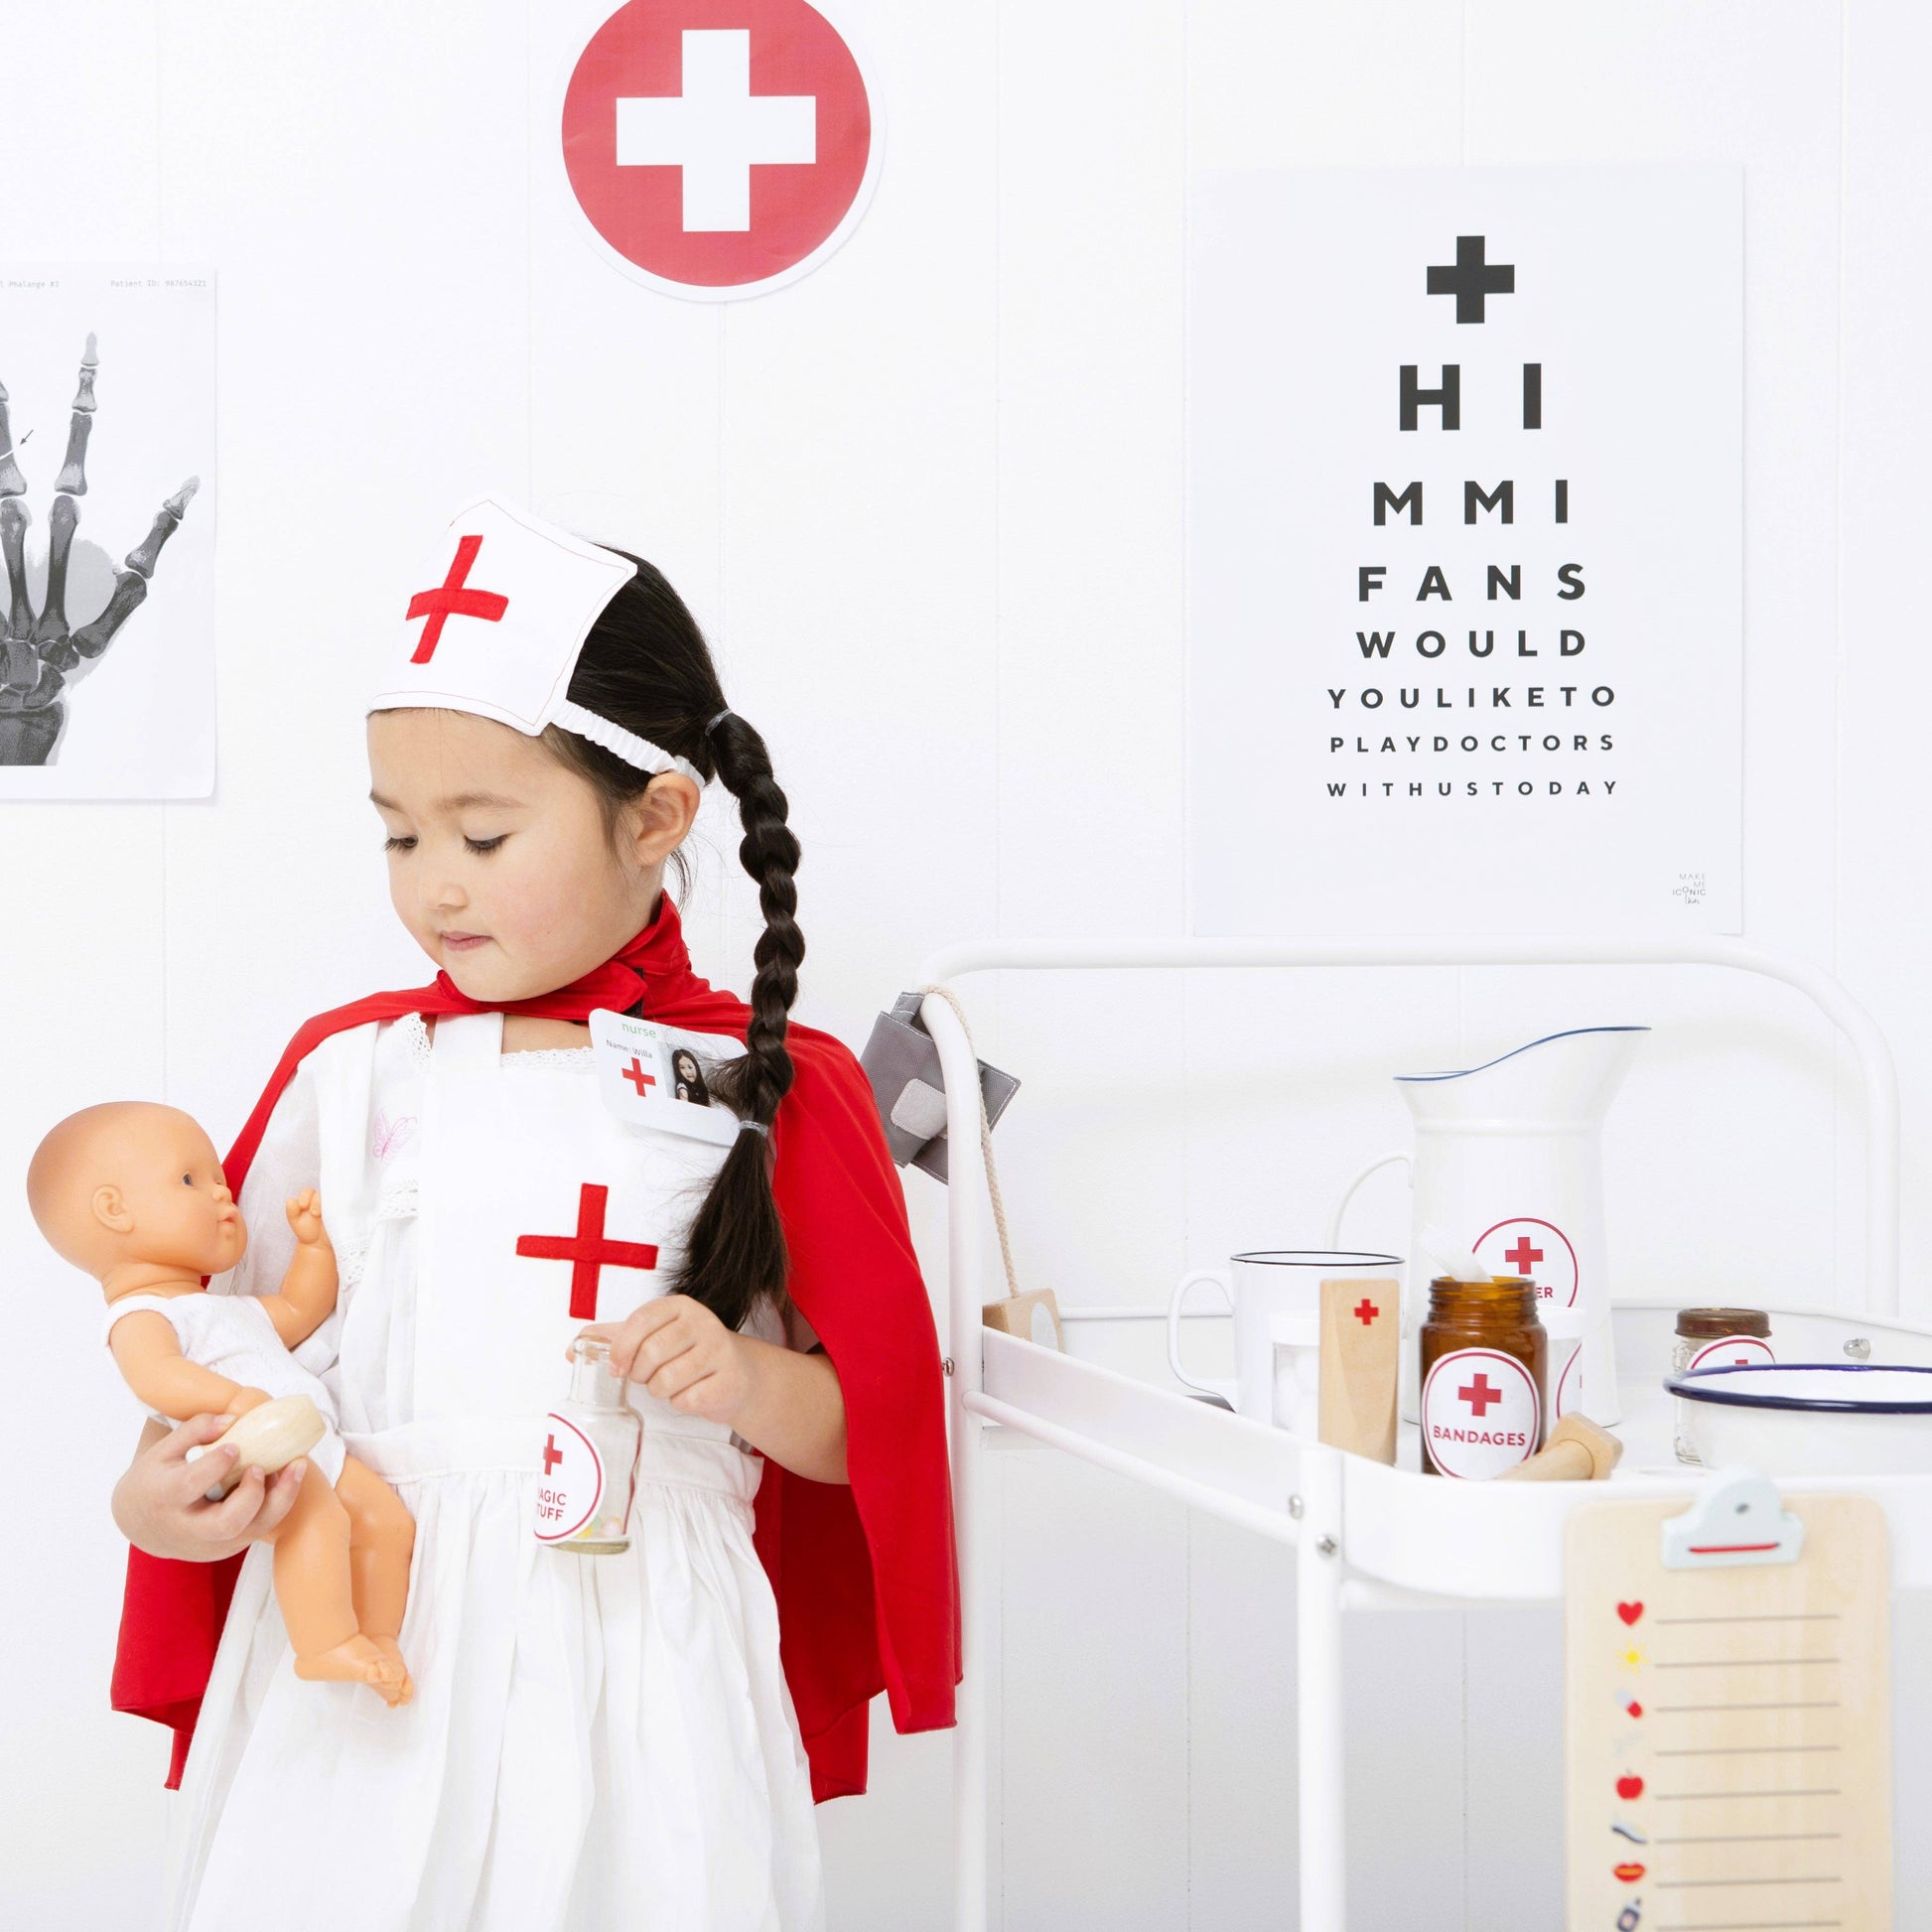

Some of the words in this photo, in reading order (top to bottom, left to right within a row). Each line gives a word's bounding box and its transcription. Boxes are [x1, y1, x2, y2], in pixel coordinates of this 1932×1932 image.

[1399, 363, 1541, 431] HI
[1373, 480, 1568, 525] MMI
[1359, 563, 1586, 602] FANS
[1356, 630, 1586, 658] WOULD
[1672, 886, 1707, 897] ICONIC
[621, 1023, 656, 1038] nurse
[606, 1039, 631, 1052] Name:
[632, 1047, 653, 1058] Willa
[1433, 1425, 1526, 1447] BANDAGES
[538, 1487, 567, 1506] AGIC
